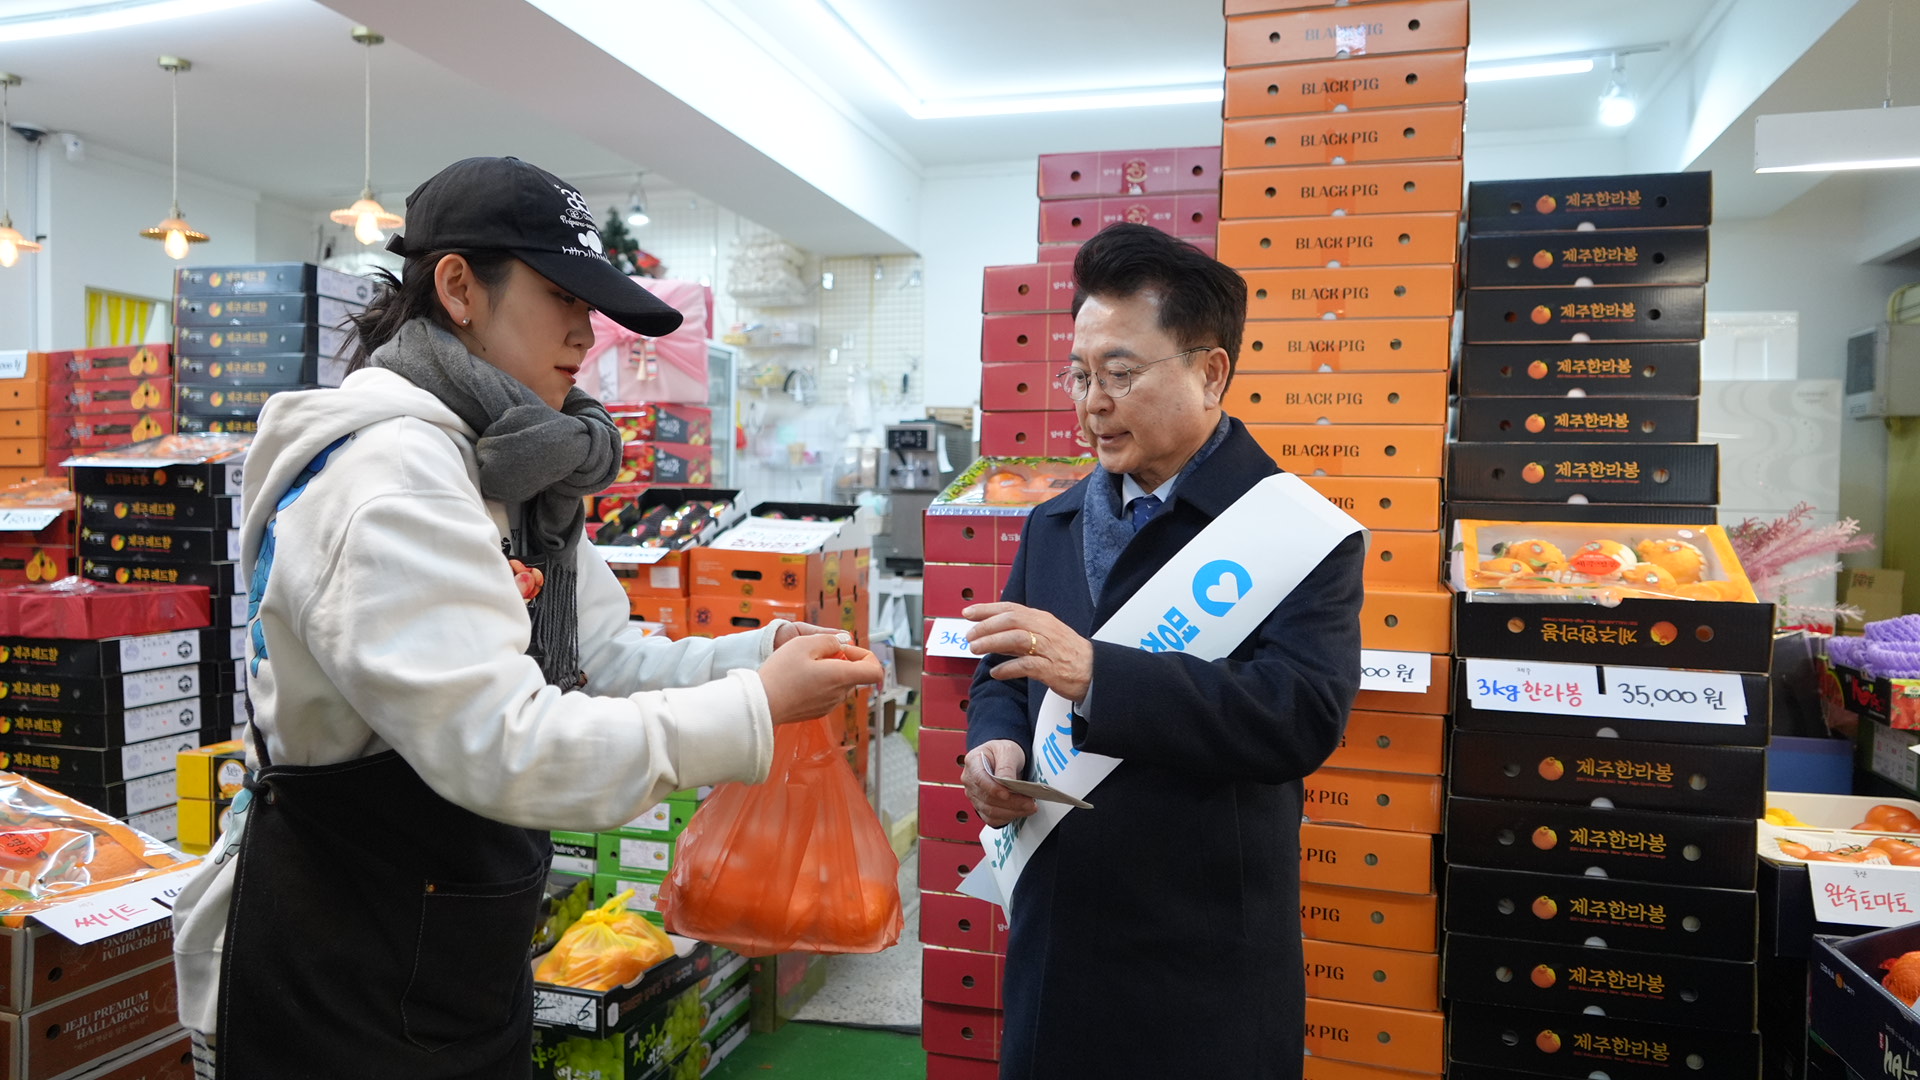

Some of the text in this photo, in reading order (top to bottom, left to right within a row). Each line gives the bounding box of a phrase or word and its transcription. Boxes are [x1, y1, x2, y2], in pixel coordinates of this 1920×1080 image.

[1301, 78, 1380, 95] BLACK PIG
[1301, 130, 1378, 147] BLACK PIG
[1301, 184, 1378, 199] BLACK PIG
[1565, 190, 1642, 207] 제주한라봉
[1296, 236, 1374, 250] BLACK PIG
[1562, 246, 1638, 263] 제주한라봉
[1292, 287, 1369, 300] BLACK PIG
[1560, 302, 1636, 318] 제주한라봉
[1288, 340, 1366, 352] BLACK PIG
[1557, 358, 1632, 374] 제주한라봉
[1286, 393, 1363, 405] BLACK PIG
[1554, 412, 1630, 429] 제주한라봉
[1282, 444, 1360, 458] BLACK PIG
[1555, 461, 1640, 478] 제주한라봉
[1541, 623, 1638, 646] 제주한라봉
[12, 646, 59, 662] 제주레드향
[1360, 664, 1415, 683] 00 원
[12, 681, 61, 698] 제주레드향
[1476, 678, 1727, 710] 3kg 한라봉 35,000 원
[14, 716, 62, 734] 제주레드향
[12, 752, 60, 770] 제주레드향
[1576, 758, 1674, 782] 제주한라봉
[1319, 790, 1349, 806] PIG
[1570, 828, 1667, 853] 제주한라봉
[1306, 848, 1336, 864] PIG
[1824, 882, 1914, 914] 완숙토마토
[1310, 906, 1340, 922] PIG
[1570, 898, 1667, 924] 제주한라봉
[1314, 965, 1344, 980] PIG
[1568, 966, 1665, 994] 제주한라봉
[63, 1013, 92, 1034] JEJU
[94, 990, 149, 1020] PREMIUM
[76, 1002, 149, 1040] HALLABONG
[1318, 1026, 1350, 1042] PIG
[1573, 1033, 1670, 1061] 제주한라봉
